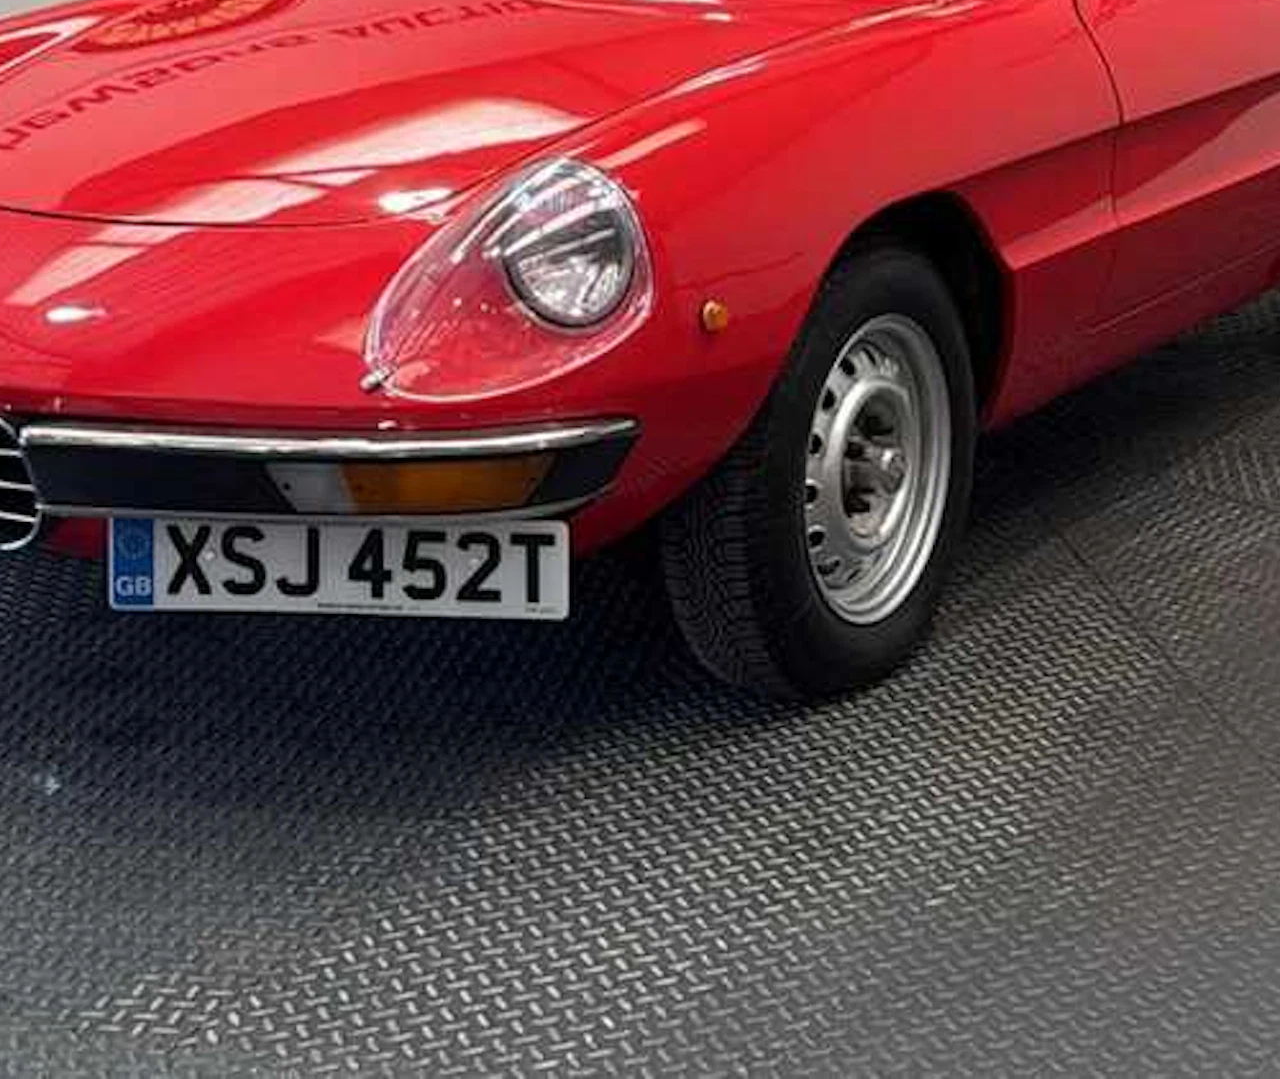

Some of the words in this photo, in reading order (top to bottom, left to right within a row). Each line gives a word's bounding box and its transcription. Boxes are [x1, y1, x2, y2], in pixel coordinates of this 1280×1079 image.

[115, 575, 151, 597] GB
[165, 524, 319, 597] XSJ
[347, 528, 556, 604] 452T
